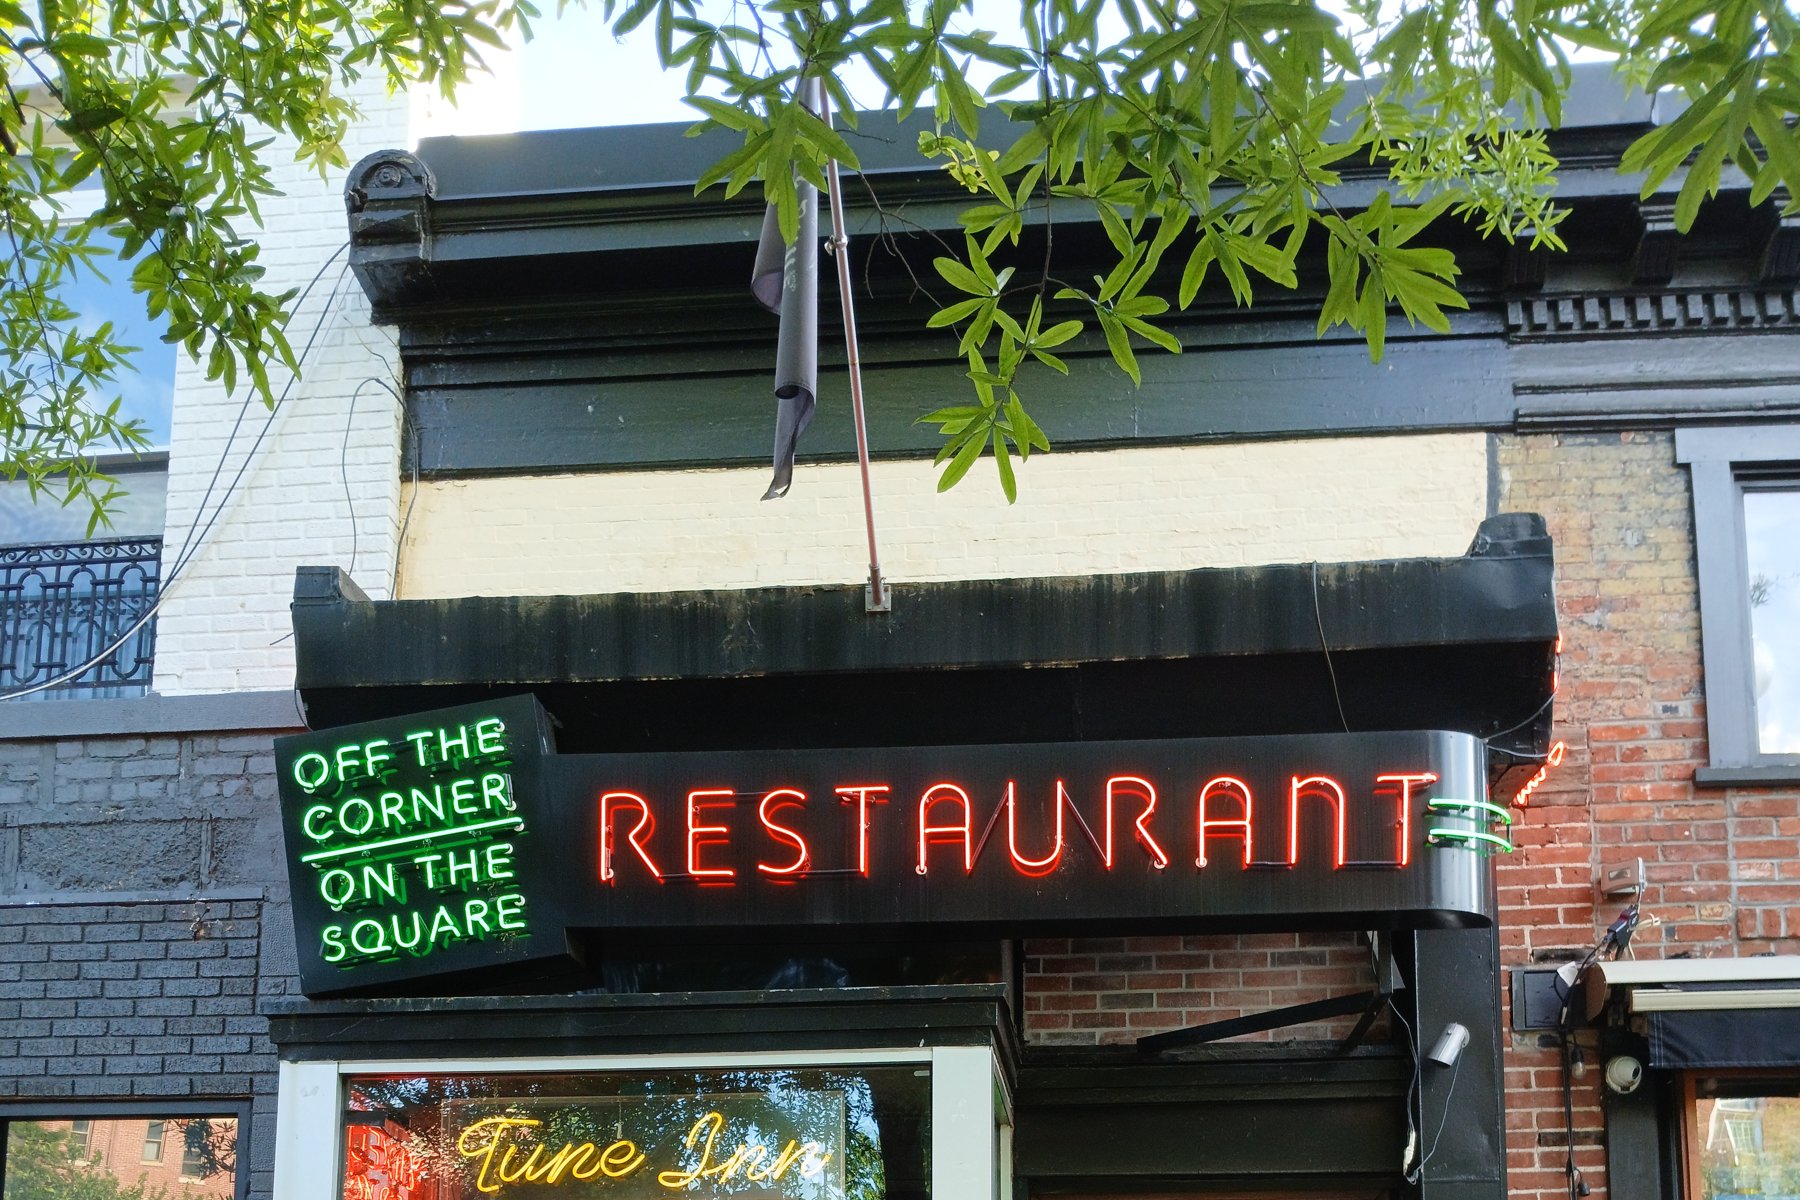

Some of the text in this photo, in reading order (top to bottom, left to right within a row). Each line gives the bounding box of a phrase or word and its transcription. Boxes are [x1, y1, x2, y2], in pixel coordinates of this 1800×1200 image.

[294, 718, 504, 788] OFF THE
[303, 774, 510, 840] CORNER
[600, 774, 1438, 882] RESTAURANT
[320, 843, 513, 905] ON THE
[322, 894, 525, 962] SQUARE
[458, 1116, 646, 1193] Tune
[657, 1111, 831, 1188] Inn
